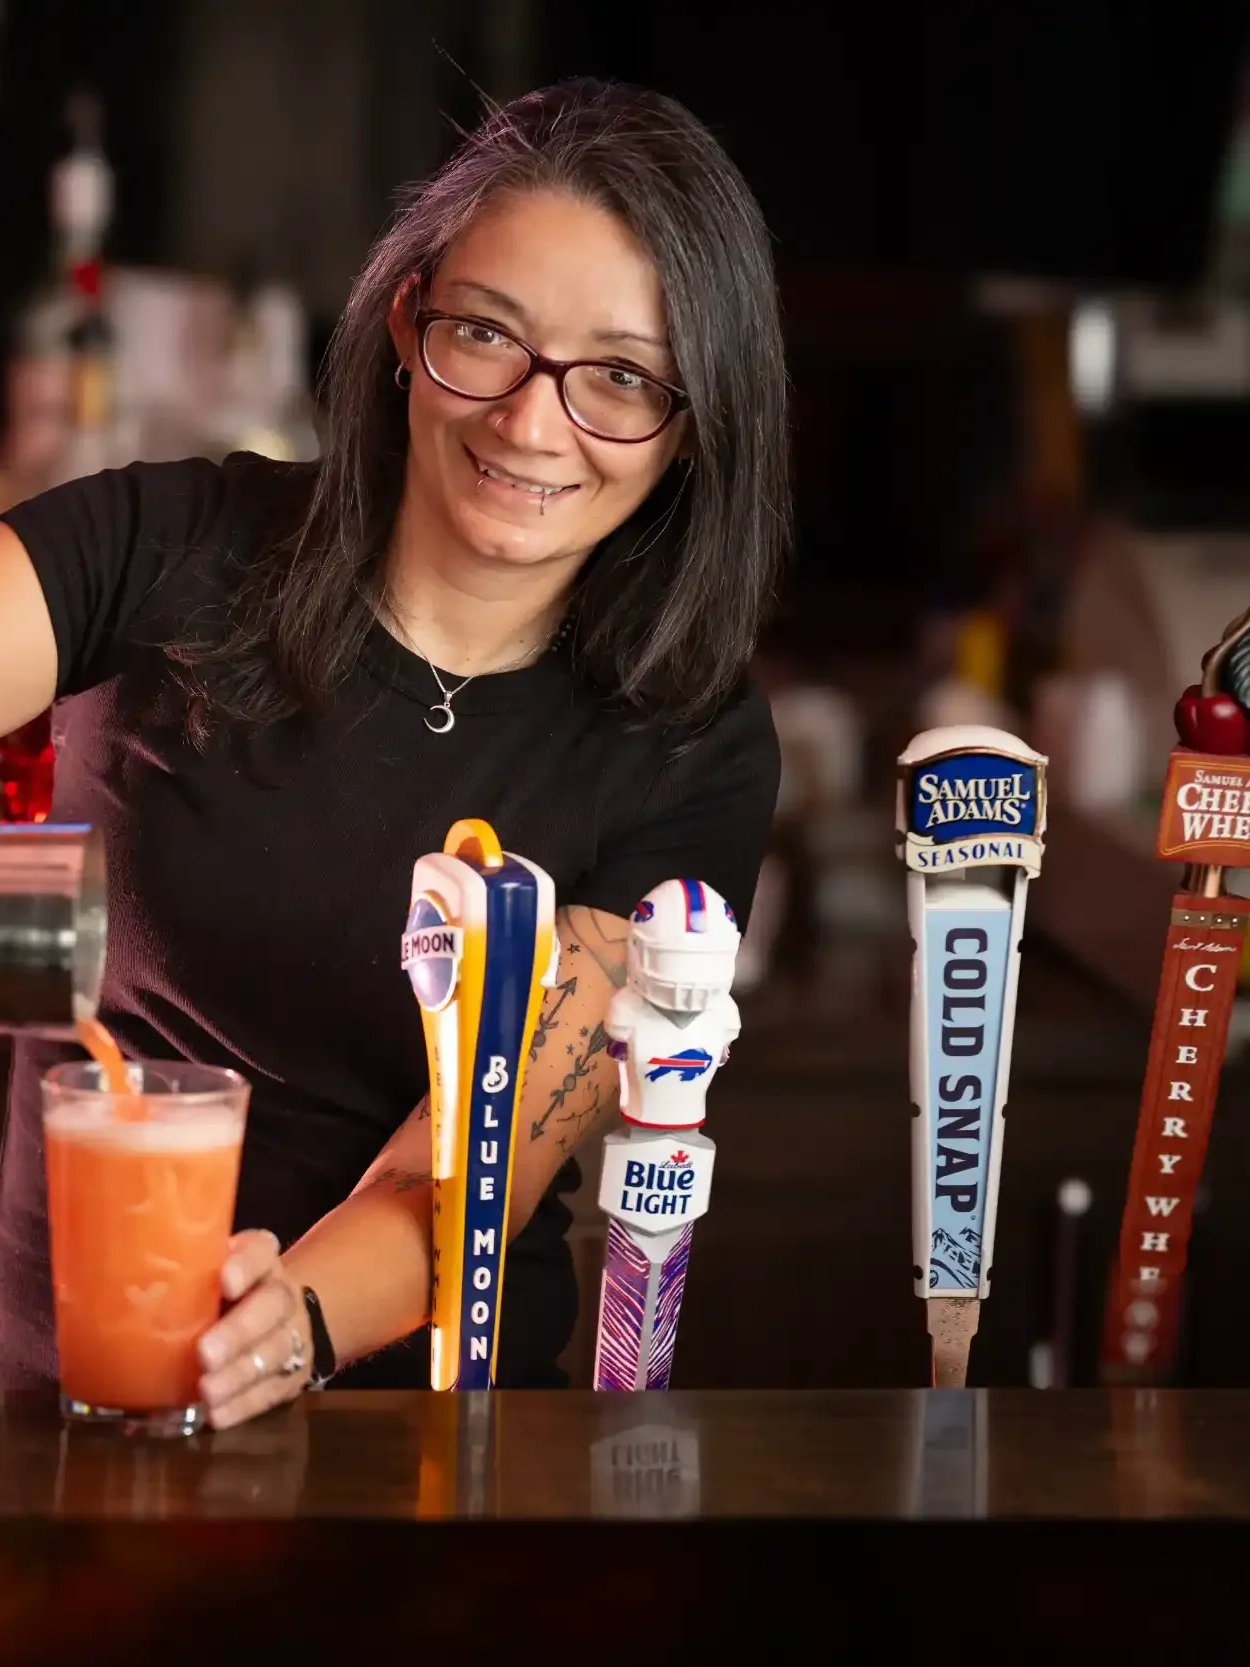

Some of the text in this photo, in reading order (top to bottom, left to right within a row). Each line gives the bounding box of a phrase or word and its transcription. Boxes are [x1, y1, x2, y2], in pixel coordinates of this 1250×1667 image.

[918, 773, 1030, 803] SAMUEL
[1193, 769, 1243, 787] SAMUEL
[925, 799, 1022, 828] ADAMS
[917, 842, 1025, 867] SEASONAL
[412, 933, 455, 957] MOON
[935, 927, 989, 1214] COLD SNAP
[1158, 964, 1217, 1174] CHERRY
[624, 1160, 695, 1191] Blue
[470, 1055, 510, 1361] BLUE MOON
[620, 1190, 692, 1215] LIGHT
